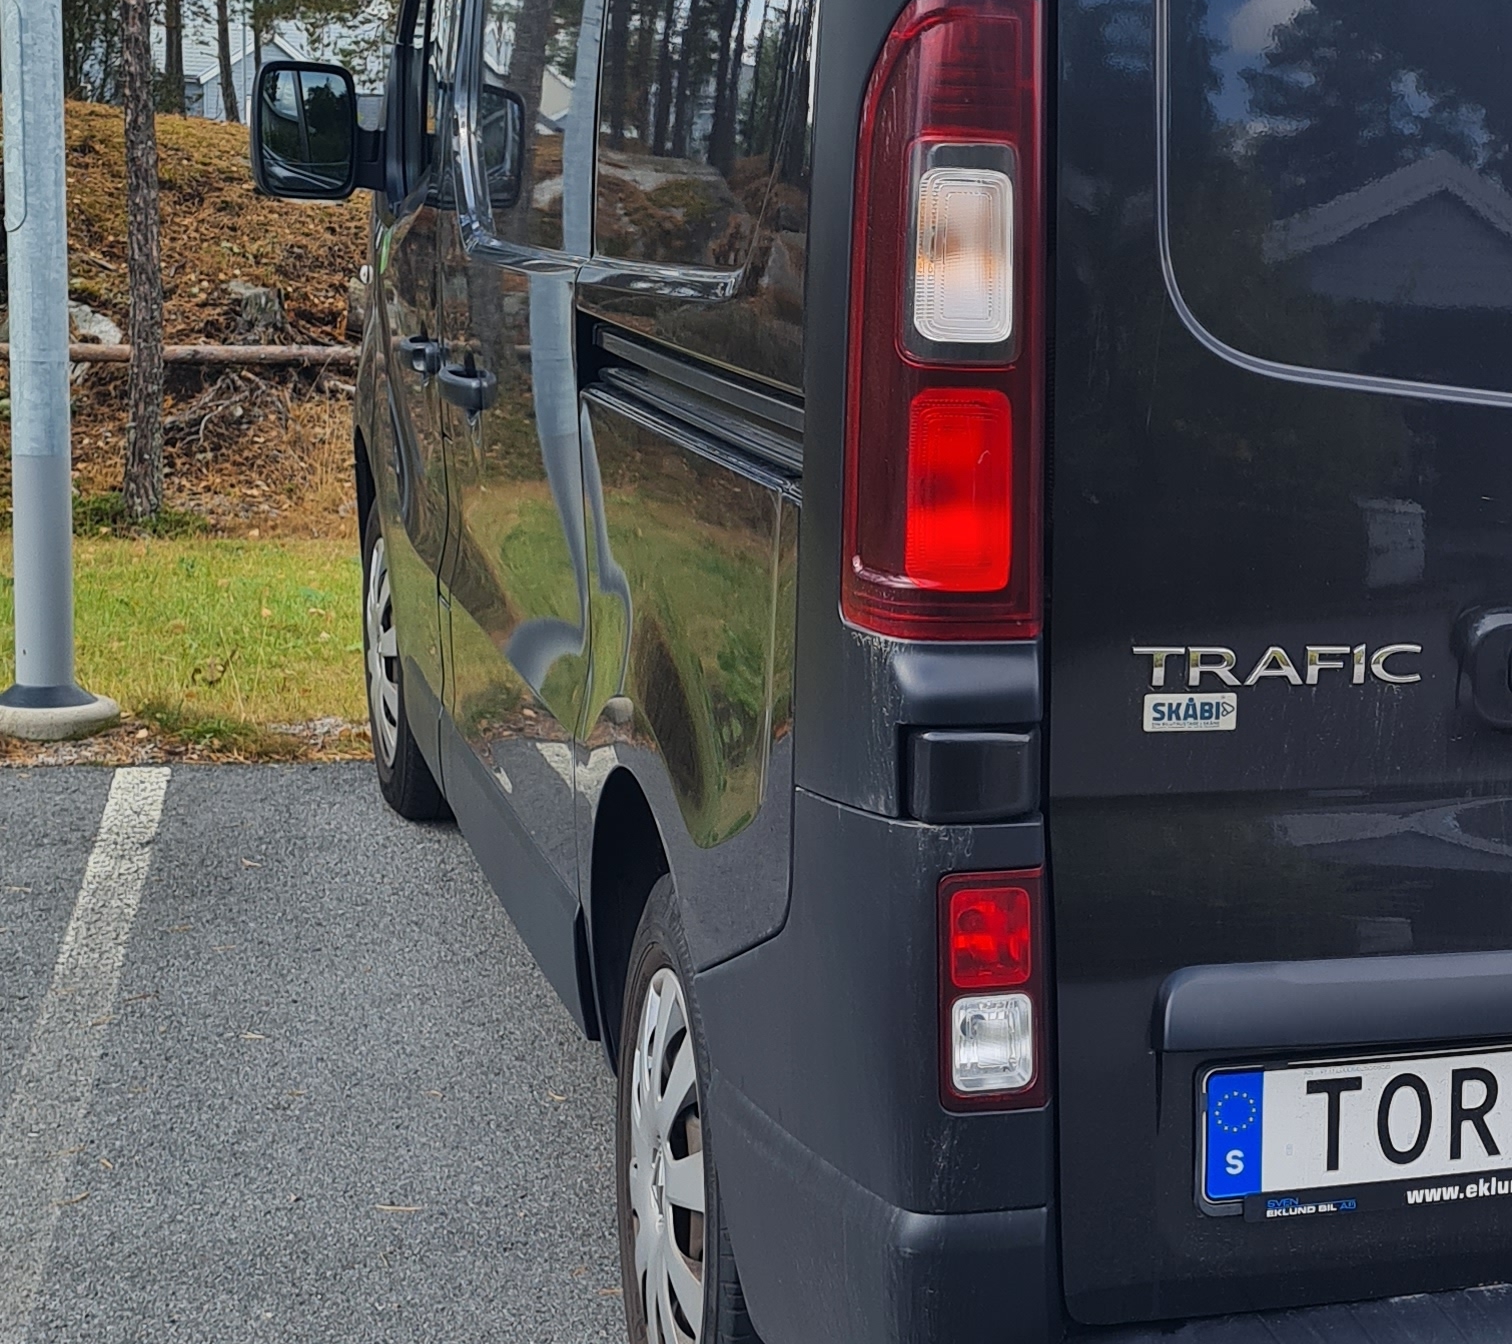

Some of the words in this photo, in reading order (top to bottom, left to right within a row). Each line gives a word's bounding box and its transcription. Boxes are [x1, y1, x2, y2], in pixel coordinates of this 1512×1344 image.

[1131, 643, 1422, 687] TRAFIC
[1152, 697, 1221, 722] SKÅBI
[1305, 1067, 1501, 1171] TOR
[1225, 1149, 1245, 1175] S
[1266, 1205, 1316, 1218] EKLUND
[1318, 1203, 1338, 1213] BIL
